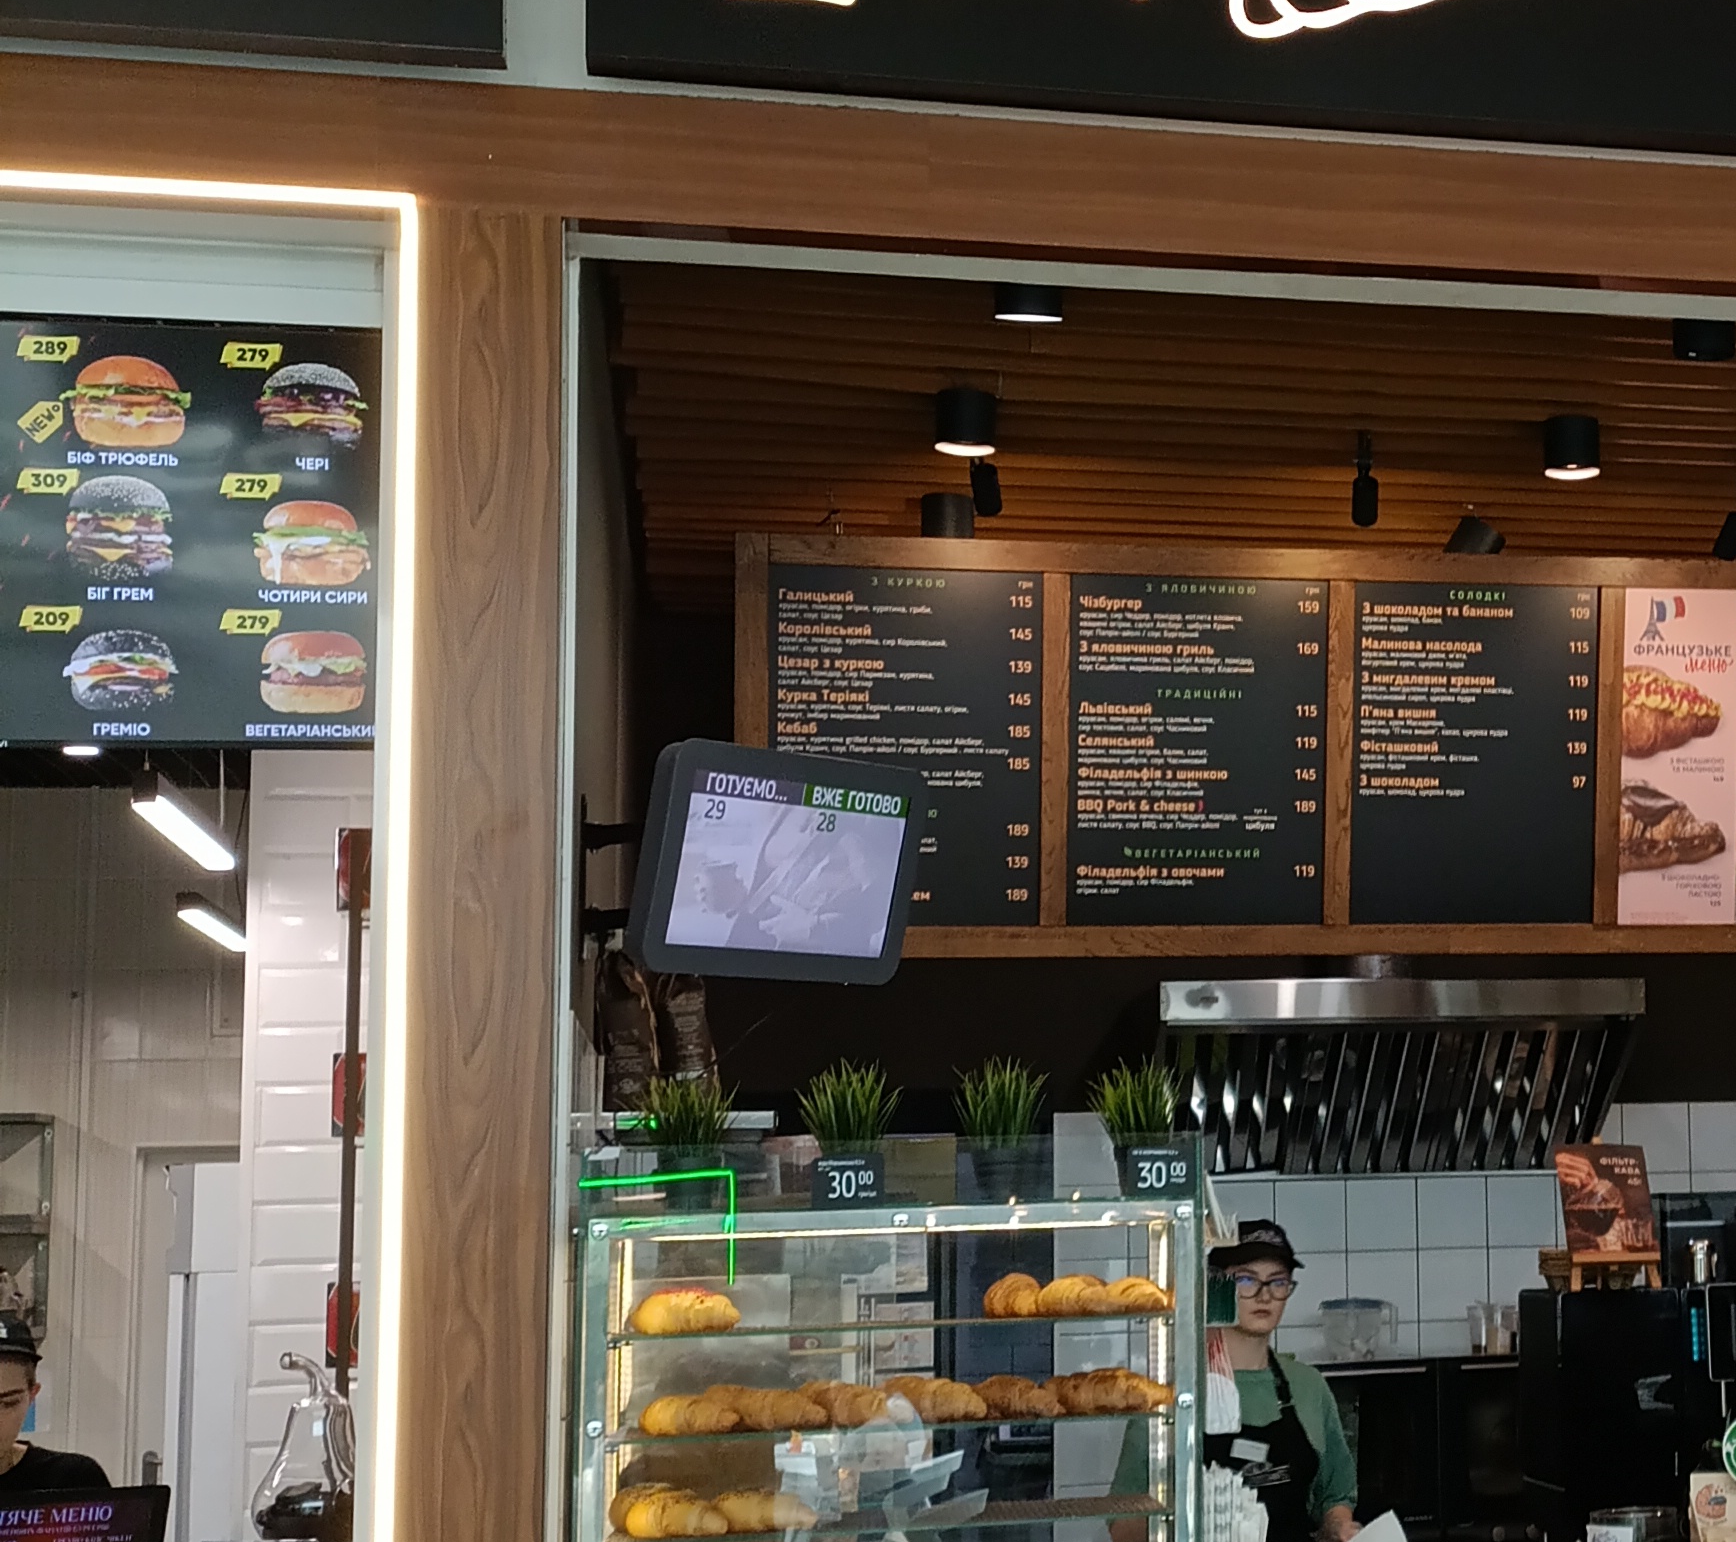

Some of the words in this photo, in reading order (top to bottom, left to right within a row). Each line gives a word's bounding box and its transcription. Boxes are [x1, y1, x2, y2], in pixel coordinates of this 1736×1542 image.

[32, 340, 68, 356] 289
[236, 348, 269, 363] 279
[24, 408, 54, 438] NEW
[67, 451, 95, 465] БІФ
[98, 452, 179, 467] ТРЮФЕЛЬ
[295, 458, 330, 471] ЧЕРІ
[31, 474, 68, 488] 309
[234, 478, 269, 493] 279
[887, 577, 946, 588] КУРКОЮ
[1161, 583, 1257, 595] ЯЛОВИЧИНОЮ
[86, 586, 111, 601] БІГ
[258, 589, 322, 604] ЧОТИРИ
[325, 590, 368, 605] СИРИ
[778, 588, 854, 604] Галицький
[1009, 595, 1033, 608] 115
[1449, 590, 1506, 601] СОЛОДКІ
[1079, 595, 1142, 611] Чізбургер
[1297, 601, 1320, 613] 159
[1362, 601, 1371, 615] З
[1374, 605, 1443, 617] шоколадом
[1446, 607, 1459, 617] та
[1462, 604, 1513, 618] бананом
[1570, 607, 1590, 620] 109
[33, 611, 70, 627] 209
[236, 615, 269, 630] 279
[778, 622, 872, 638] Королівський
[1009, 628, 1033, 641] 145
[1079, 640, 1088, 652] З
[1091, 643, 1173, 655] яловичиною
[1176, 644, 1215, 656] гриль
[1296, 642, 1319, 655] 169
[1361, 637, 1423, 651] Малинова
[1426, 640, 1483, 653] насолода
[1569, 641, 1590, 654] 115
[1633, 644, 1732, 659] ФРАНЦУЗЬКЕ
[777, 655, 819, 670] Цезар
[835, 659, 885, 672] куркою
[1008, 661, 1032, 673] 139
[1361, 671, 1370, 684] З
[1372, 674, 1447, 686] мигдалевим
[1450, 675, 1495, 687] кремом
[1568, 675, 1589, 688] 119
[777, 689, 817, 704] Курка
[821, 690, 870, 704] Теріякі
[1008, 693, 1031, 706] 145
[1156, 688, 1242, 700] ТРАДИЦІЙНІ
[1078, 701, 1152, 715] Львівський
[1295, 705, 1318, 718] 115
[1398, 708, 1437, 719] вишня
[1567, 708, 1588, 721] 119
[92, 722, 151, 737] ГРЕМІО
[245, 724, 376, 738] ВЕГЕТАРІАНСЬКИ
[777, 721, 817, 735] Кебаб
[1007, 725, 1031, 738] 185
[1078, 733, 1155, 747] Селянський
[1295, 736, 1318, 749] 119
[1360, 739, 1439, 754] Фісташковий
[1567, 742, 1588, 755] 139
[1007, 757, 1030, 771] 185
[1077, 766, 1162, 782] Філадельфія
[1176, 769, 1228, 781] шинкою
[1294, 769, 1316, 781] 145
[1359, 774, 1367, 787] З
[1370, 777, 1440, 788] шоколадом
[1572, 776, 1587, 788] 97
[704, 771, 788, 802] ГОТУЄМО...
[812, 785, 842, 808] ВЖЕ
[846, 790, 901, 815] ГОТОВО
[1077, 799, 1103, 812] BBQ
[1107, 799, 1136, 812] Pork
[1140, 800, 1149, 812] &
[1153, 800, 1196, 813] cheese
[1294, 800, 1316, 813] 189
[703, 798, 727, 821] 29
[816, 812, 837, 833] 28
[1006, 824, 1029, 837] 189
[1134, 848, 1260, 859] ВЕГЕТАРІАНСЬКИЙ
[1006, 856, 1029, 869] 139
[1076, 865, 1158, 879] Філадельфія
[1171, 867, 1224, 878] овочами
[1293, 865, 1315, 877] 119
[1005, 889, 1029, 902] 189
[1137, 1161, 1166, 1189] 30
[1170, 1161, 1186, 1177] 00
[1614, 1166, 1640, 1175] КАВА
[828, 1170, 856, 1199] 30
[858, 1170, 874, 1186] 00
[50, 1505, 113, 1524] МЕНЮ
